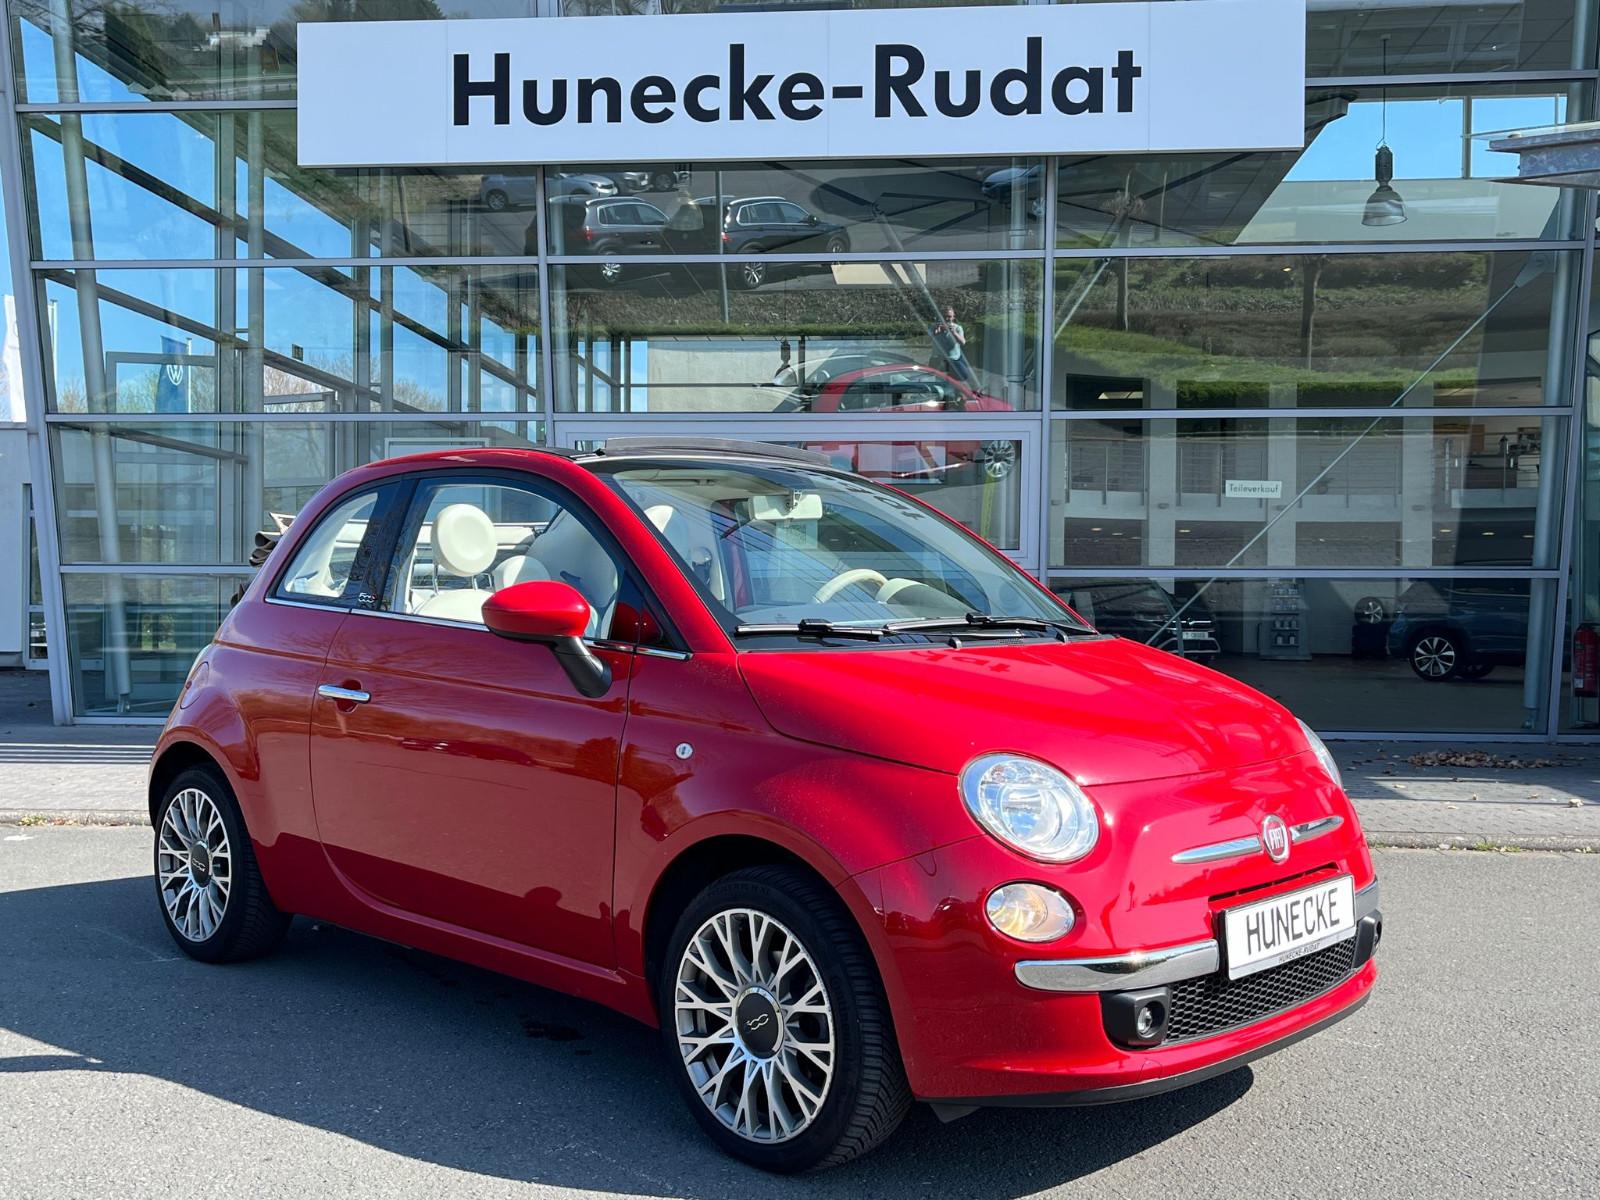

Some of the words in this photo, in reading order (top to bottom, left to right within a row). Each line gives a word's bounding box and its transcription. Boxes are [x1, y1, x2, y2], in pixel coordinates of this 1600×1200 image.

[453, 36, 1142, 126] Hunecke-Rudat
[1230, 483, 1278, 493] Teileverkauf
[1246, 888, 1340, 954] HUNECKE
